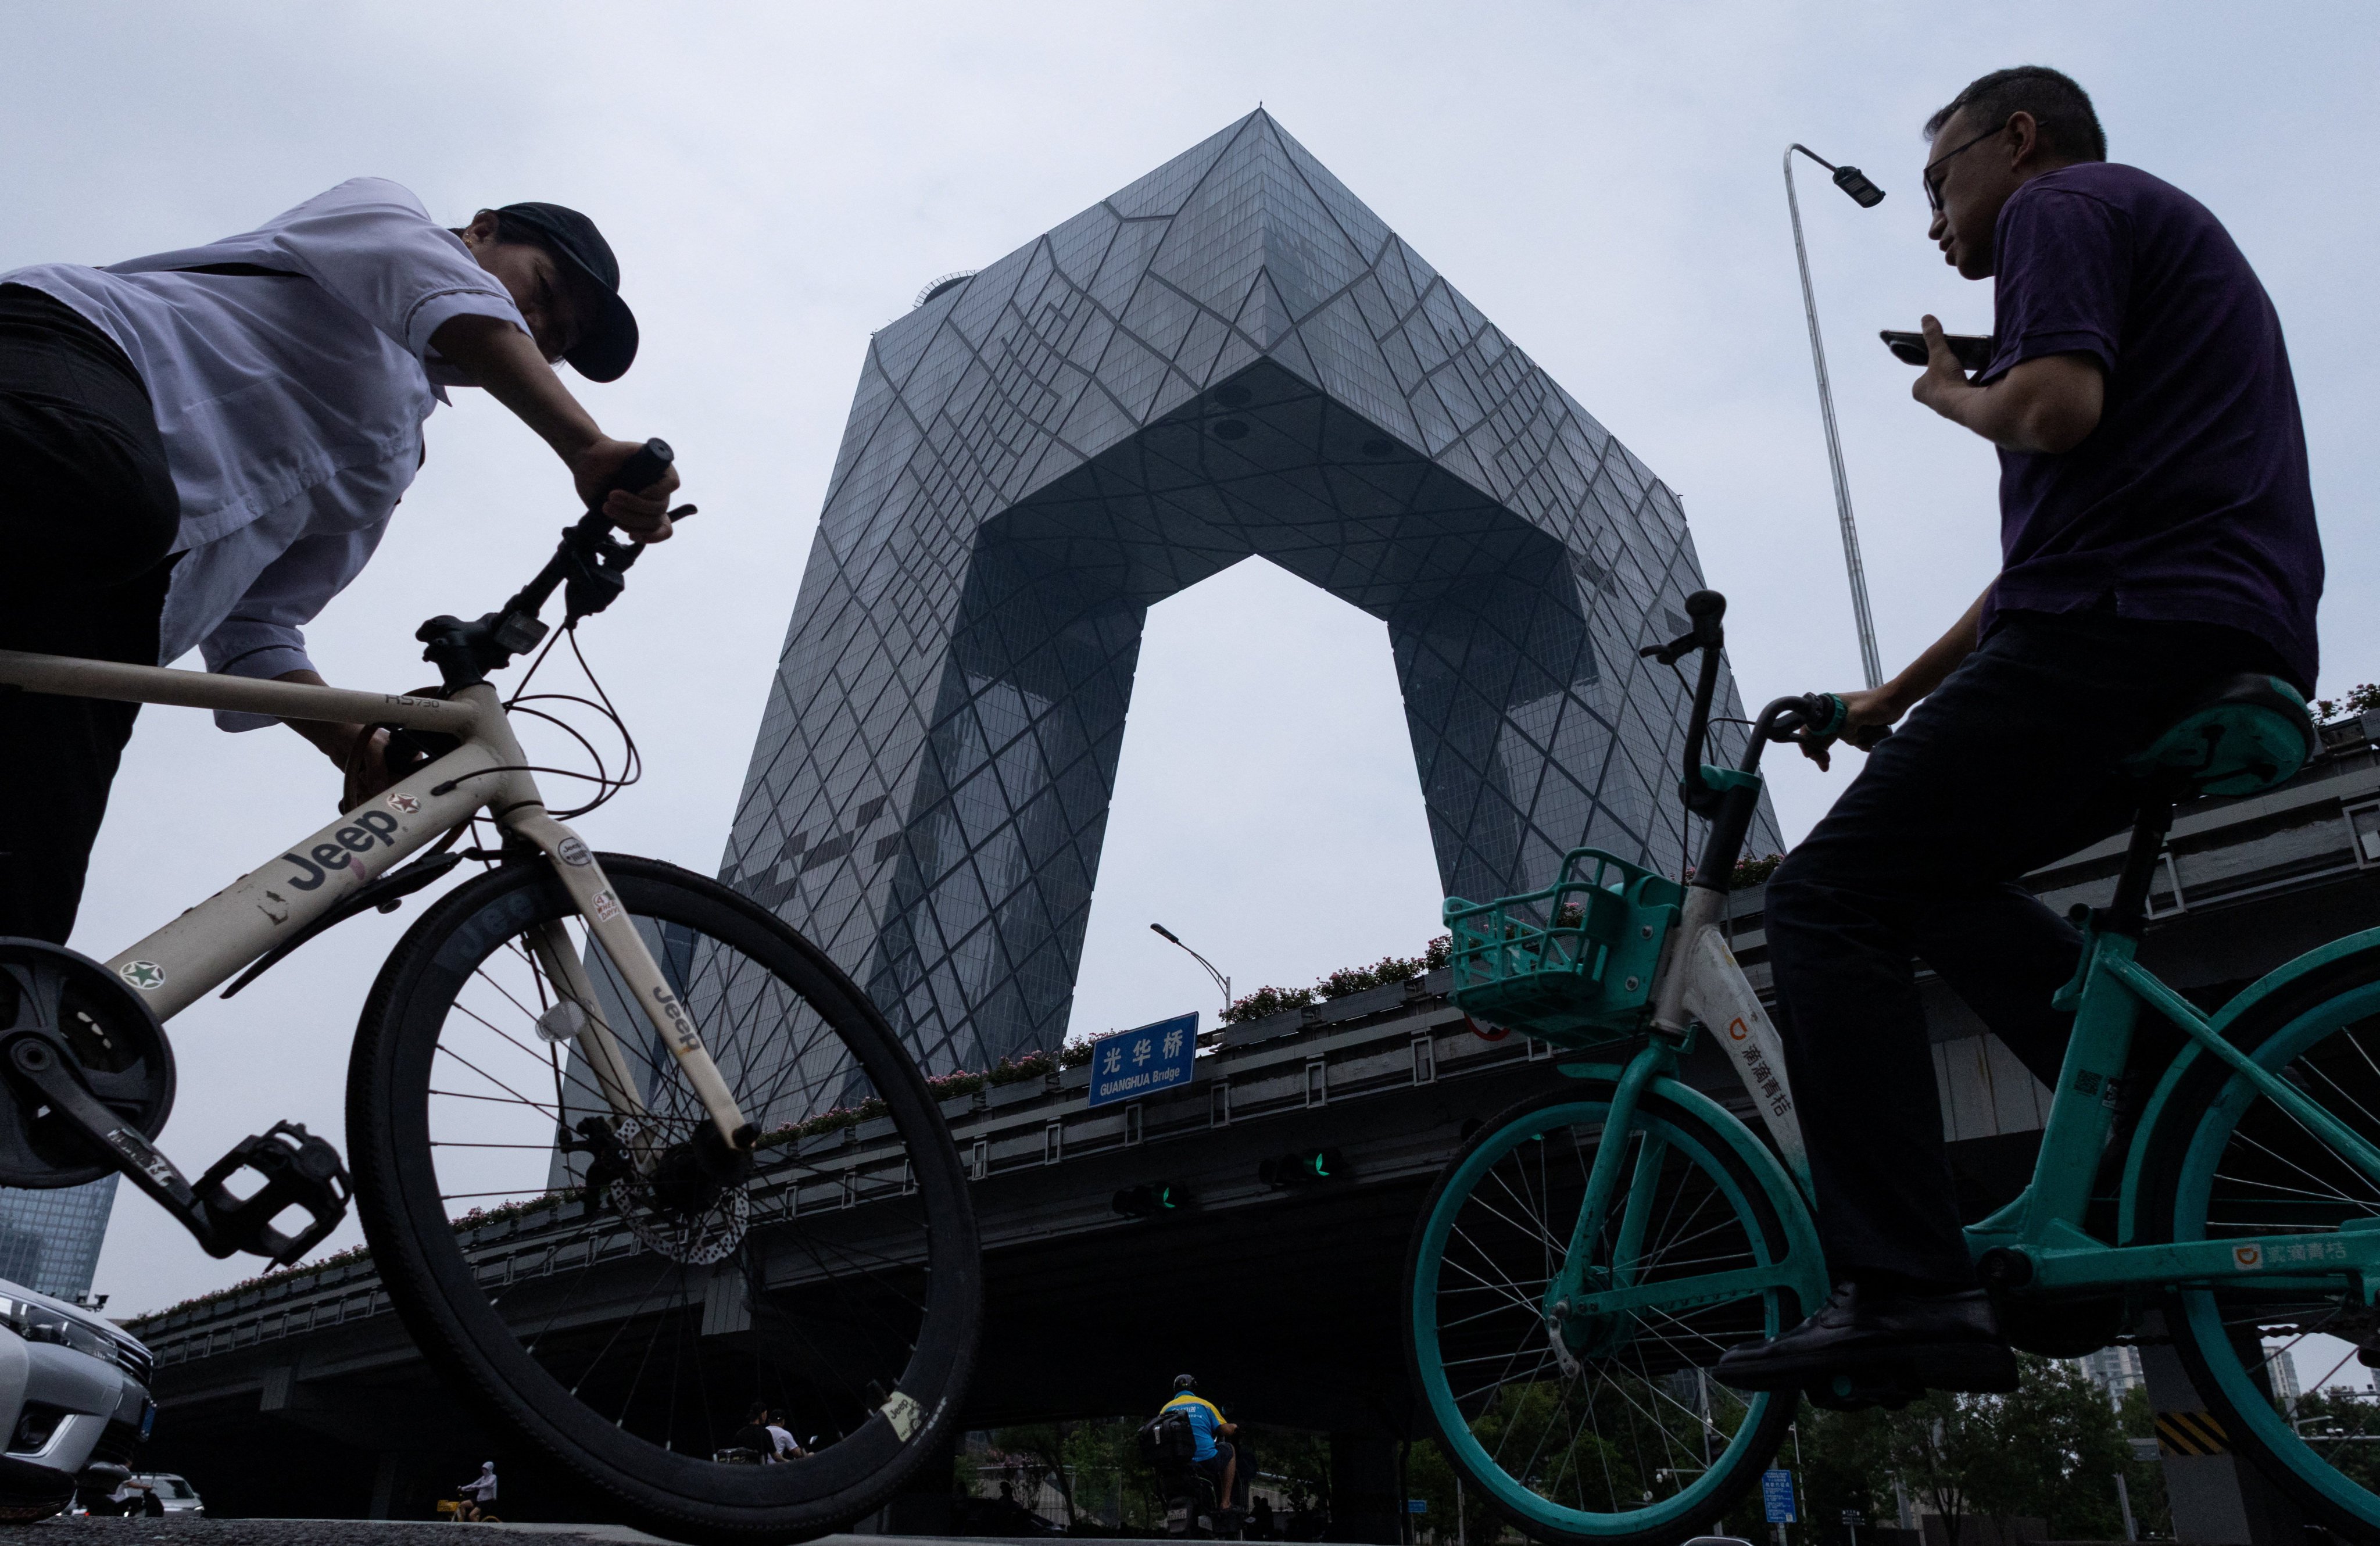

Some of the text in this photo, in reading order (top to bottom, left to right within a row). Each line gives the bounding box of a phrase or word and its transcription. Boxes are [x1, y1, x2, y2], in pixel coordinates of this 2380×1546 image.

[282, 810, 398, 891] Jeep
[459, 890, 545, 959] Jee
[602, 906, 620, 921] DRIV
[653, 987, 700, 1050] Jeep
[1103, 1029, 1183, 1075] 光华桥
[1100, 1067, 1180, 1096] GUANGHUA Bridge
[1742, 1044, 1792, 1116] 滴滴青桔
[890, 1399, 908, 1419] Jeep
